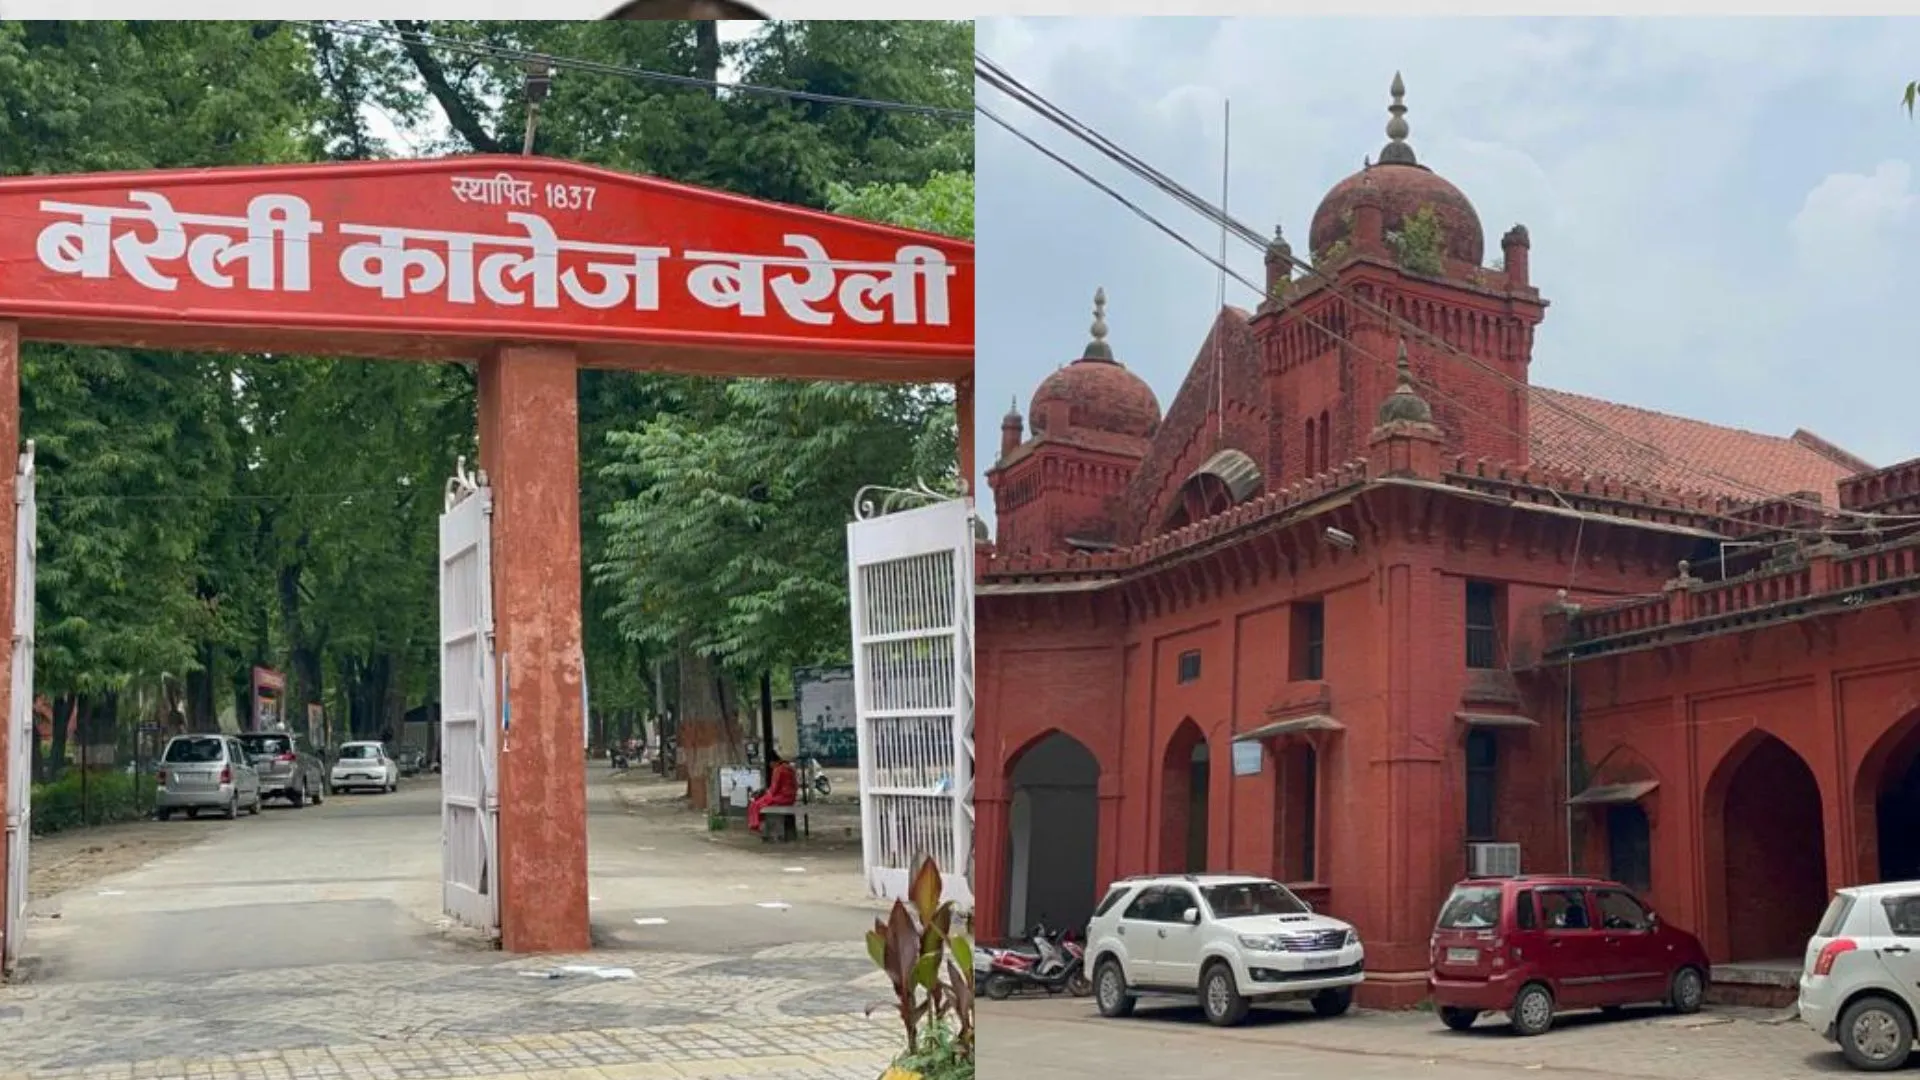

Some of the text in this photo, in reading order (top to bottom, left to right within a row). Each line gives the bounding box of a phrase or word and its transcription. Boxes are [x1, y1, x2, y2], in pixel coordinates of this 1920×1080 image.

[450, 172, 597, 211] स्थापित- 1837
[35, 189, 956, 326] बरेली कालेज बरेली
